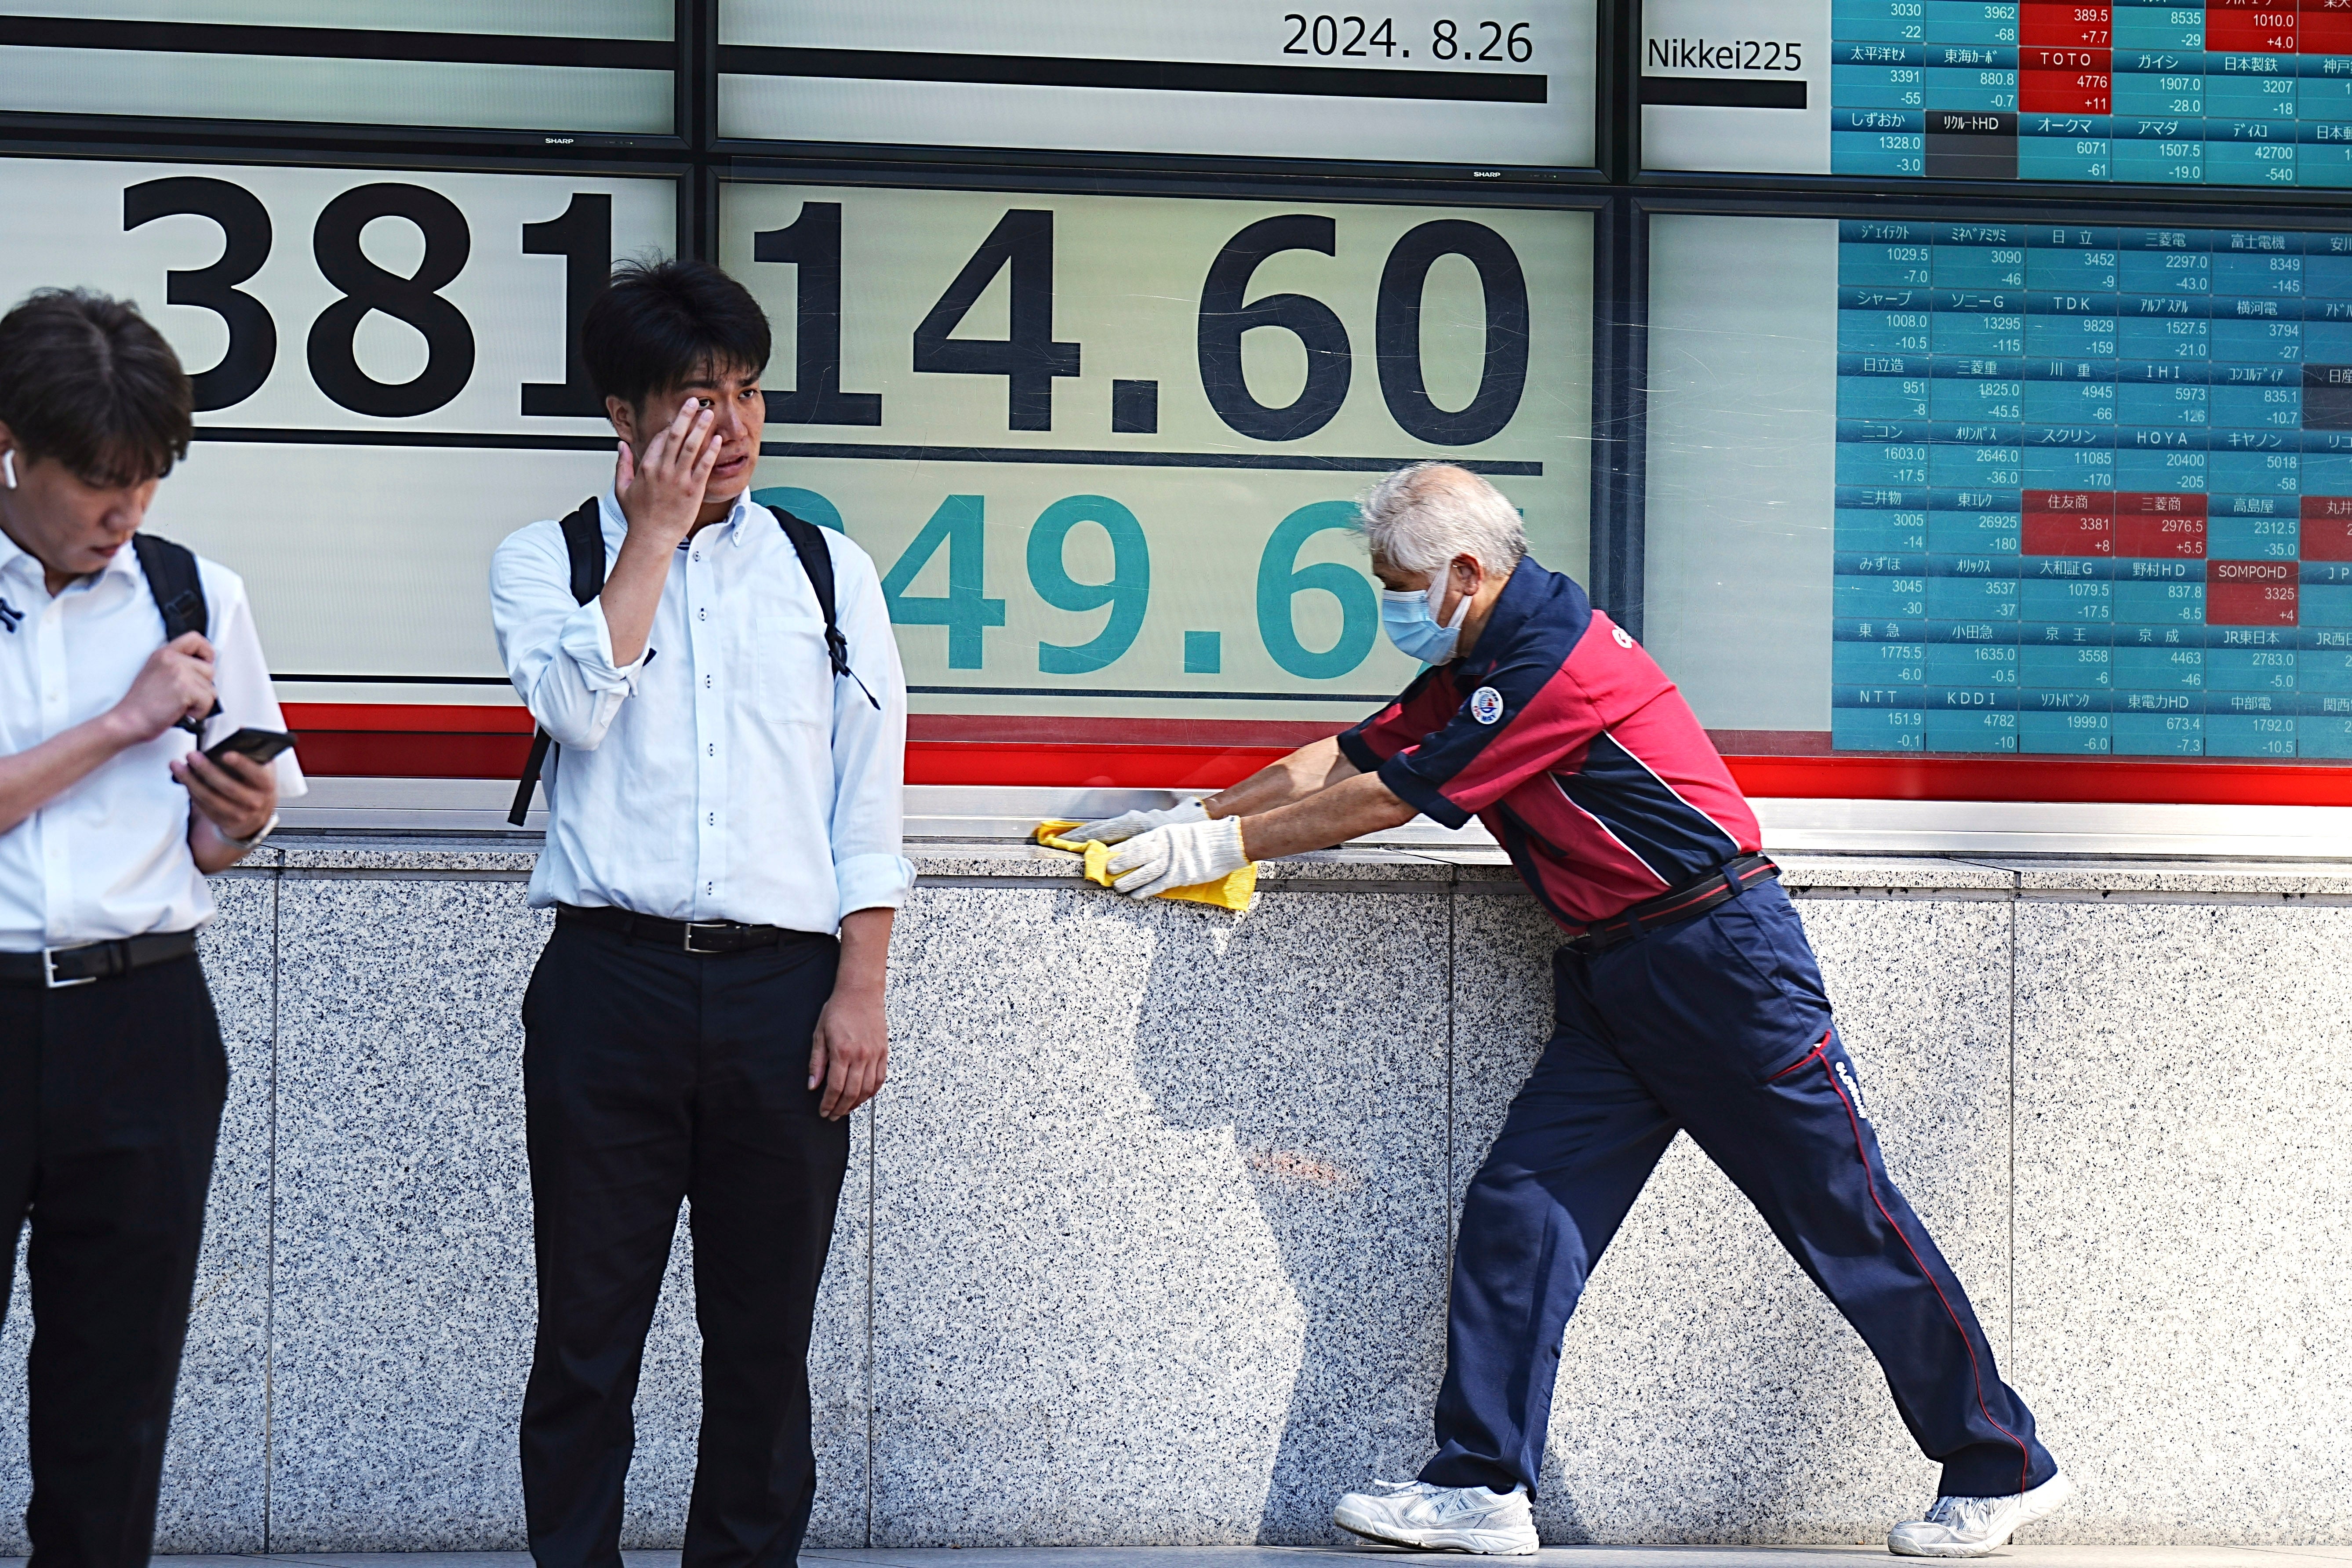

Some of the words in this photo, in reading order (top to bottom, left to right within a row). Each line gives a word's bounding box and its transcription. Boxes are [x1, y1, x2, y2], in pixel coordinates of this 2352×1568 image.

[1890, 3, 1921, 16] 3030
[1984, 6, 2014, 19] 3962
[2074, 8, 2108, 22] 389.5
[2170, 11, 2201, 24] 8535
[2253, 14, 2294, 27] 1010.0
[1901, 25, 1921, 38] -22
[1995, 28, 2014, 41] -68
[2081, 30, 2108, 43] +7.7
[1283, 14, 1409, 58] 2024.
[1432, 19, 1533, 63] 8.26
[2181, 33, 2201, 46] -29
[2267, 36, 2293, 48] +4.0
[1649, 38, 1801, 71] Nikkei225
[2138, 54, 2178, 69] ガイシ
[2225, 56, 2278, 72] 日本製鉄
[1890, 69, 1919, 83] 3391
[1980, 72, 2014, 85] 880.8
[2077, 75, 2107, 88] 4776
[2160, 77, 2200, 91] 1907.0
[2263, 80, 2293, 93] 3207
[1901, 91, 1920, 105] -55
[1990, 94, 2014, 107] -0.7
[2084, 97, 2105, 109] +11
[2169, 99, 2200, 112] -28.0
[2273, 102, 2293, 115] -18
[1852, 111, 1905, 128] しずおか
[2038, 117, 2091, 133] オークマ
[2138, 119, 2178, 135] アマダ
[1879, 135, 1920, 149] 1328.0
[2076, 141, 2105, 154] 6071
[2159, 143, 2200, 157] 1507.5
[2254, 146, 2293, 160] 42700
[1896, 158, 1920, 171] -3.0
[2087, 163, 2105, 176] -61
[2168, 165, 2200, 178] -19.0
[2265, 167, 2292, 181] -540
[2145, 231, 2186, 247] 三菱電
[2231, 233, 2285, 250] 富士電機
[1887, 247, 1928, 261] 1029.5
[1991, 250, 2021, 264] 3090
[2084, 252, 2114, 266] 3452
[2166, 255, 2207, 269] 2297.0
[2270, 258, 2300, 271] 8349
[1904, 269, 1927, 283] -7.0
[2001, 272, 2021, 285] -46
[2102, 275, 2114, 287] -9
[2176, 276, 2207, 290] -43.0
[2272, 279, 2300, 292] -145
[2236, 300, 2278, 315] 横河電
[1886, 314, 1927, 327] 1008.0
[1983, 316, 2020, 330] 13295
[2083, 319, 2114, 332] 9829
[2166, 321, 2206, 335] 1527.5
[2269, 324, 2299, 337] 3794
[1895, 336, 1927, 349] -10.5
[1992, 338, 2020, 352] -115
[2086, 341, 2113, 354] -159
[2175, 342, 2206, 357] -21.0
[2279, 345, 2299, 359] -27
[1864, 357, 1905, 373] 日立造
[1956, 359, 1997, 375] 三菱重
[1903, 381, 1924, 394] 951
[1978, 383, 2020, 397] 1825.0
[2082, 385, 2112, 398] 4945
[2175, 387, 2205, 400] 5973
[2264, 389, 2296, 403] 835.1
[1913, 403, 1926, 415] -8
[1988, 404, 2019, 418] -45.5
[2092, 407, 2112, 420] -66
[2178, 409, 2205, 422] -126
[2266, 411, 2297, 424] -10.7
[1884, 447, 1925, 460] 1603.0
[1976, 448, 2018, 462] 2646.0
[2074, 451, 2111, 465] 11085
[2166, 453, 2204, 467] 20400
[2267, 455, 2297, 469] 5018
[1893, 469, 1924, 482] -17.5
[1986, 471, 2018, 484] -36.0
[2083, 473, 2111, 487] -170
[2176, 475, 2203, 488] -205
[2277, 477, 2296, 490] -58
[1861, 489, 1901, 506] 三井物
[2047, 493, 2087, 509] 住友商
[2141, 495, 2181, 511] 三菱商
[2234, 497, 2274, 513] 高島屋
[1893, 513, 1923, 526] 3005
[1978, 515, 2017, 528] 26925
[2080, 517, 2108, 530] 3381
[2162, 519, 2203, 532] 2976.5
[2254, 521, 2295, 535] 2312.5
[1903, 535, 1923, 548] -14
[1989, 537, 2016, 550] -180
[2094, 539, 2109, 552] +8
[2176, 541, 2203, 554] +5.5
[2264, 542, 2295, 556] -35.0
[1859, 555, 1901, 571] みずほ
[2039, 560, 2092, 576] 大和証G
[2218, 565, 2287, 578] SOMPOHD
[1892, 579, 1922, 593] 3045
[1985, 581, 2016, 595] 3537
[2068, 583, 2109, 597] 1079.5
[2168, 585, 2202, 598] 837.8
[2265, 587, 2294, 600] 3325
[1902, 601, 1922, 614] -30
[1996, 603, 2015, 616] -37
[2077, 604, 2108, 618] -17.5
[2178, 606, 2202, 620] -8.5
[2279, 609, 2294, 621] +4
[1952, 623, 1993, 639] 小田急
[2223, 629, 2279, 645] JR東日本
[1881, 645, 1921, 659] 1775.5
[1974, 648, 2015, 661] 1635.0
[2078, 649, 2108, 662] 3558
[2170, 651, 2201, 664] 4463
[2252, 652, 2294, 666] 2783.0
[1898, 667, 1921, 680] -6.0
[1991, 669, 2014, 682] -0.5
[2095, 671, 2108, 684] -6
[2181, 673, 2201, 686] -46
[2270, 674, 2293, 688] -5.0
[2127, 694, 2188, 709] 東電力HD
[2231, 695, 2272, 710] 中部電
[1887, 712, 1921, 725] 151.9
[1984, 714, 2014, 727] 4782
[2067, 715, 2108, 728] 1999.0
[2167, 717, 2200, 730] 673.4
[2253, 718, 2293, 732] 1792.0
[1897, 734, 1919, 747] -0.1
[1995, 736, 2014, 749] -10
[2084, 737, 2107, 750] -6.0
[2177, 739, 2200, 752] -7.3
[2262, 740, 2293, 753] -10.5
